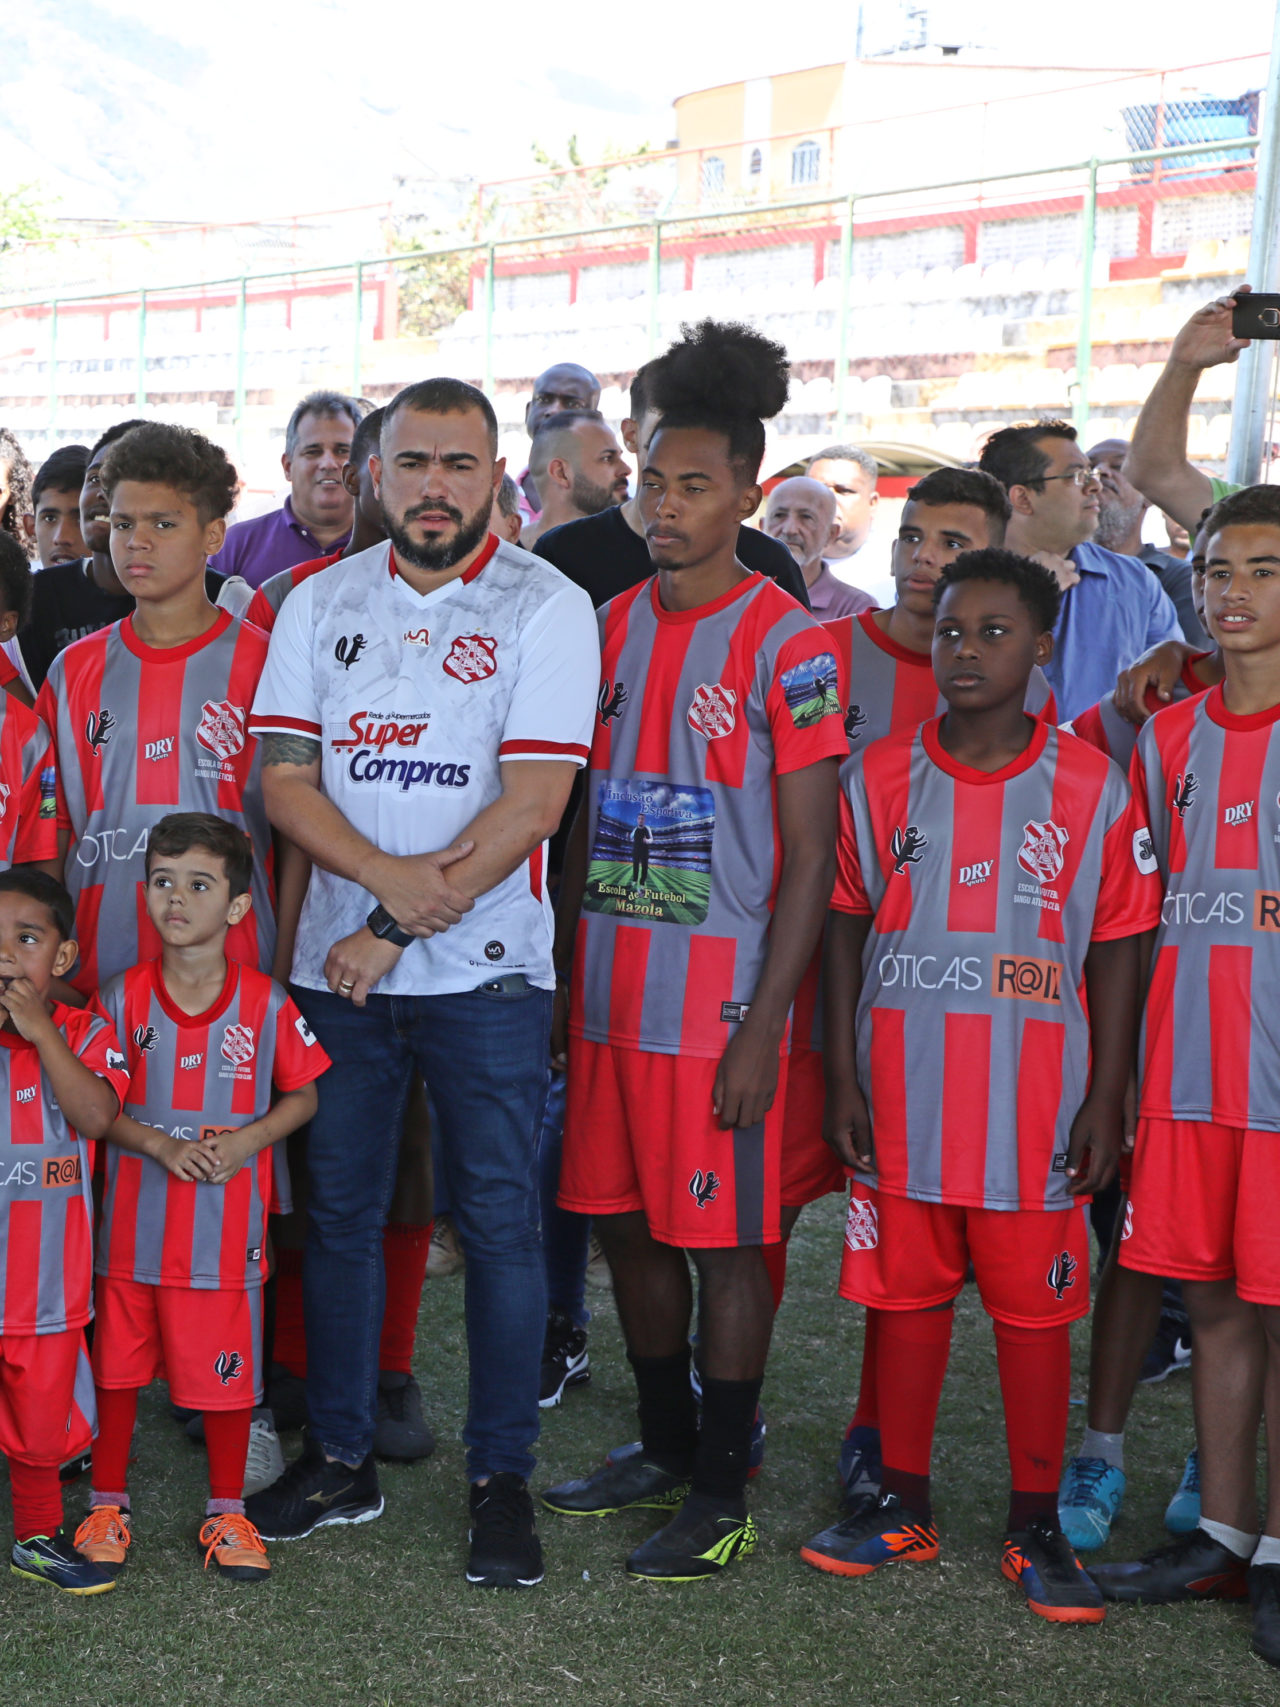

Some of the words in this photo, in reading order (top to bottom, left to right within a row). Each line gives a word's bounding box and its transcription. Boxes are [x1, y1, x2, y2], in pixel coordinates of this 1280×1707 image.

[331, 711, 428, 753] Super
[145, 736, 175, 759] DRY
[349, 750, 470, 790] Compras
[1224, 800, 1255, 824] DRY
[958, 859, 994, 884] DRY
[598, 882, 627, 896] Escola
[628, 891, 640, 901] de
[644, 888, 686, 904] Futebol
[615, 898, 664, 917] Mazola
[879, 948, 983, 990] ÓTICAS
[181, 1052, 204, 1068] DRY
[16, 1084, 37, 1101] DRY
